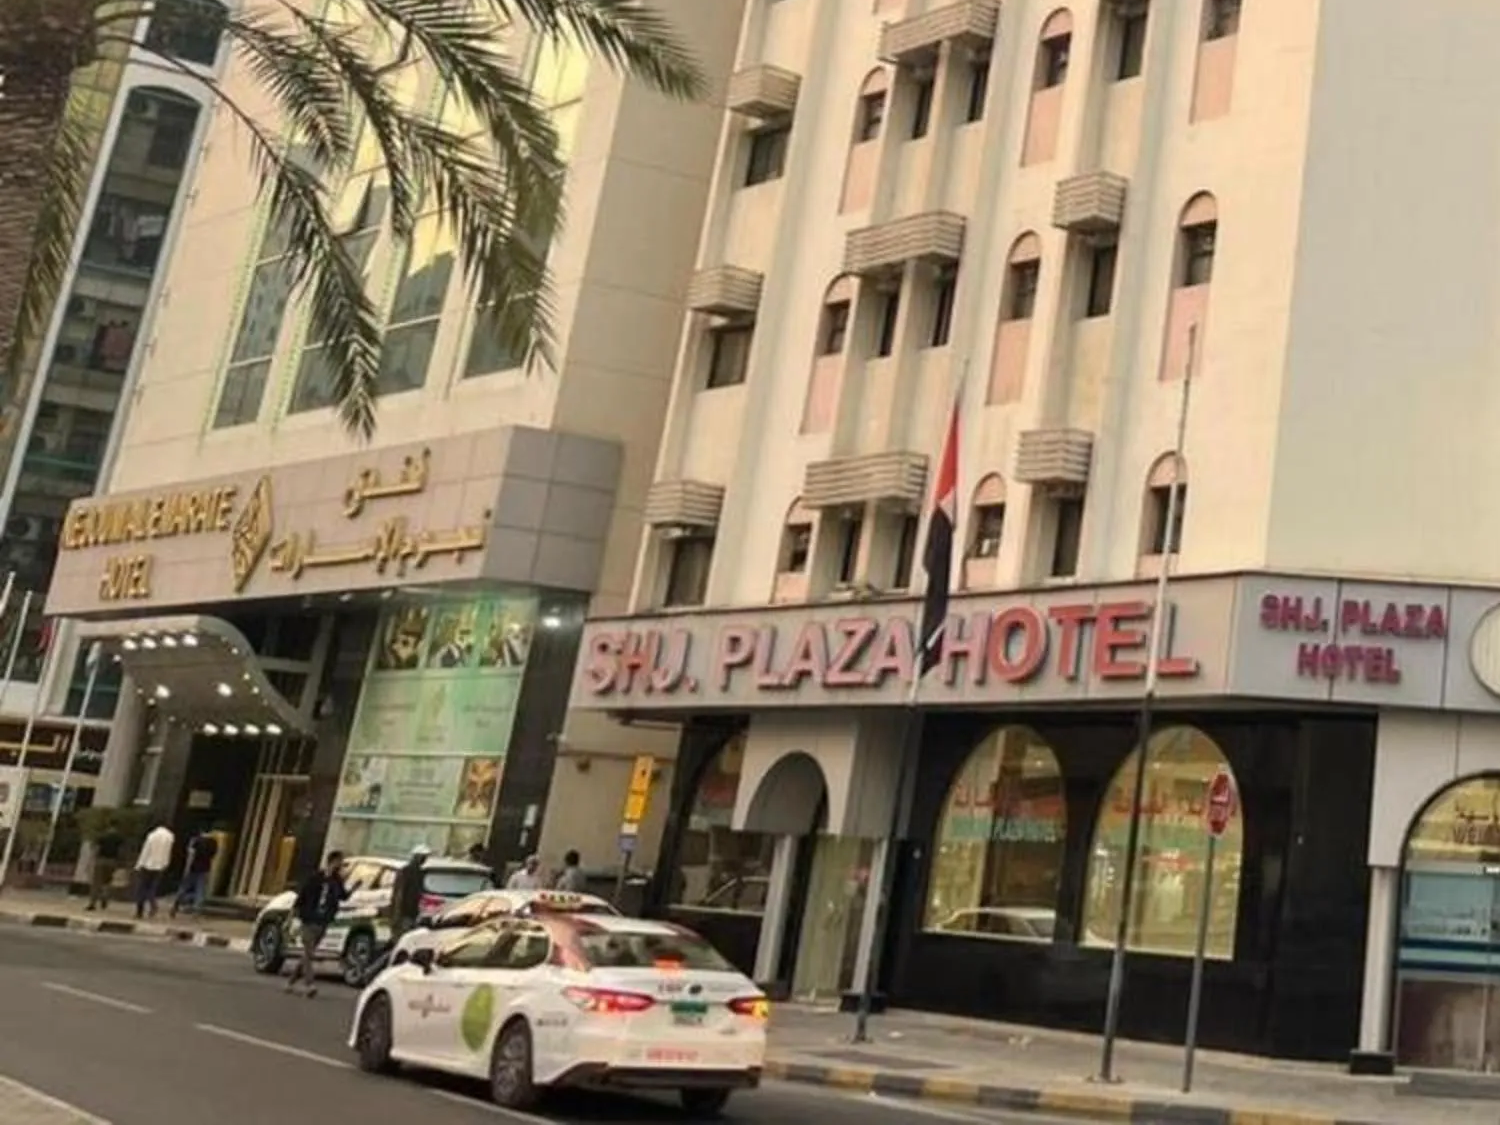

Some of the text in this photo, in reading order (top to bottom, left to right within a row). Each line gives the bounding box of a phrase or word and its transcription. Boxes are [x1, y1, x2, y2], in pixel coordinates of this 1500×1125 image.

[1260, 594, 1446, 639] SHJ. PLAZA
[586, 599, 1199, 696] SHJ. PLAZA HOTEL
[1296, 642, 1402, 685] HOTEL
